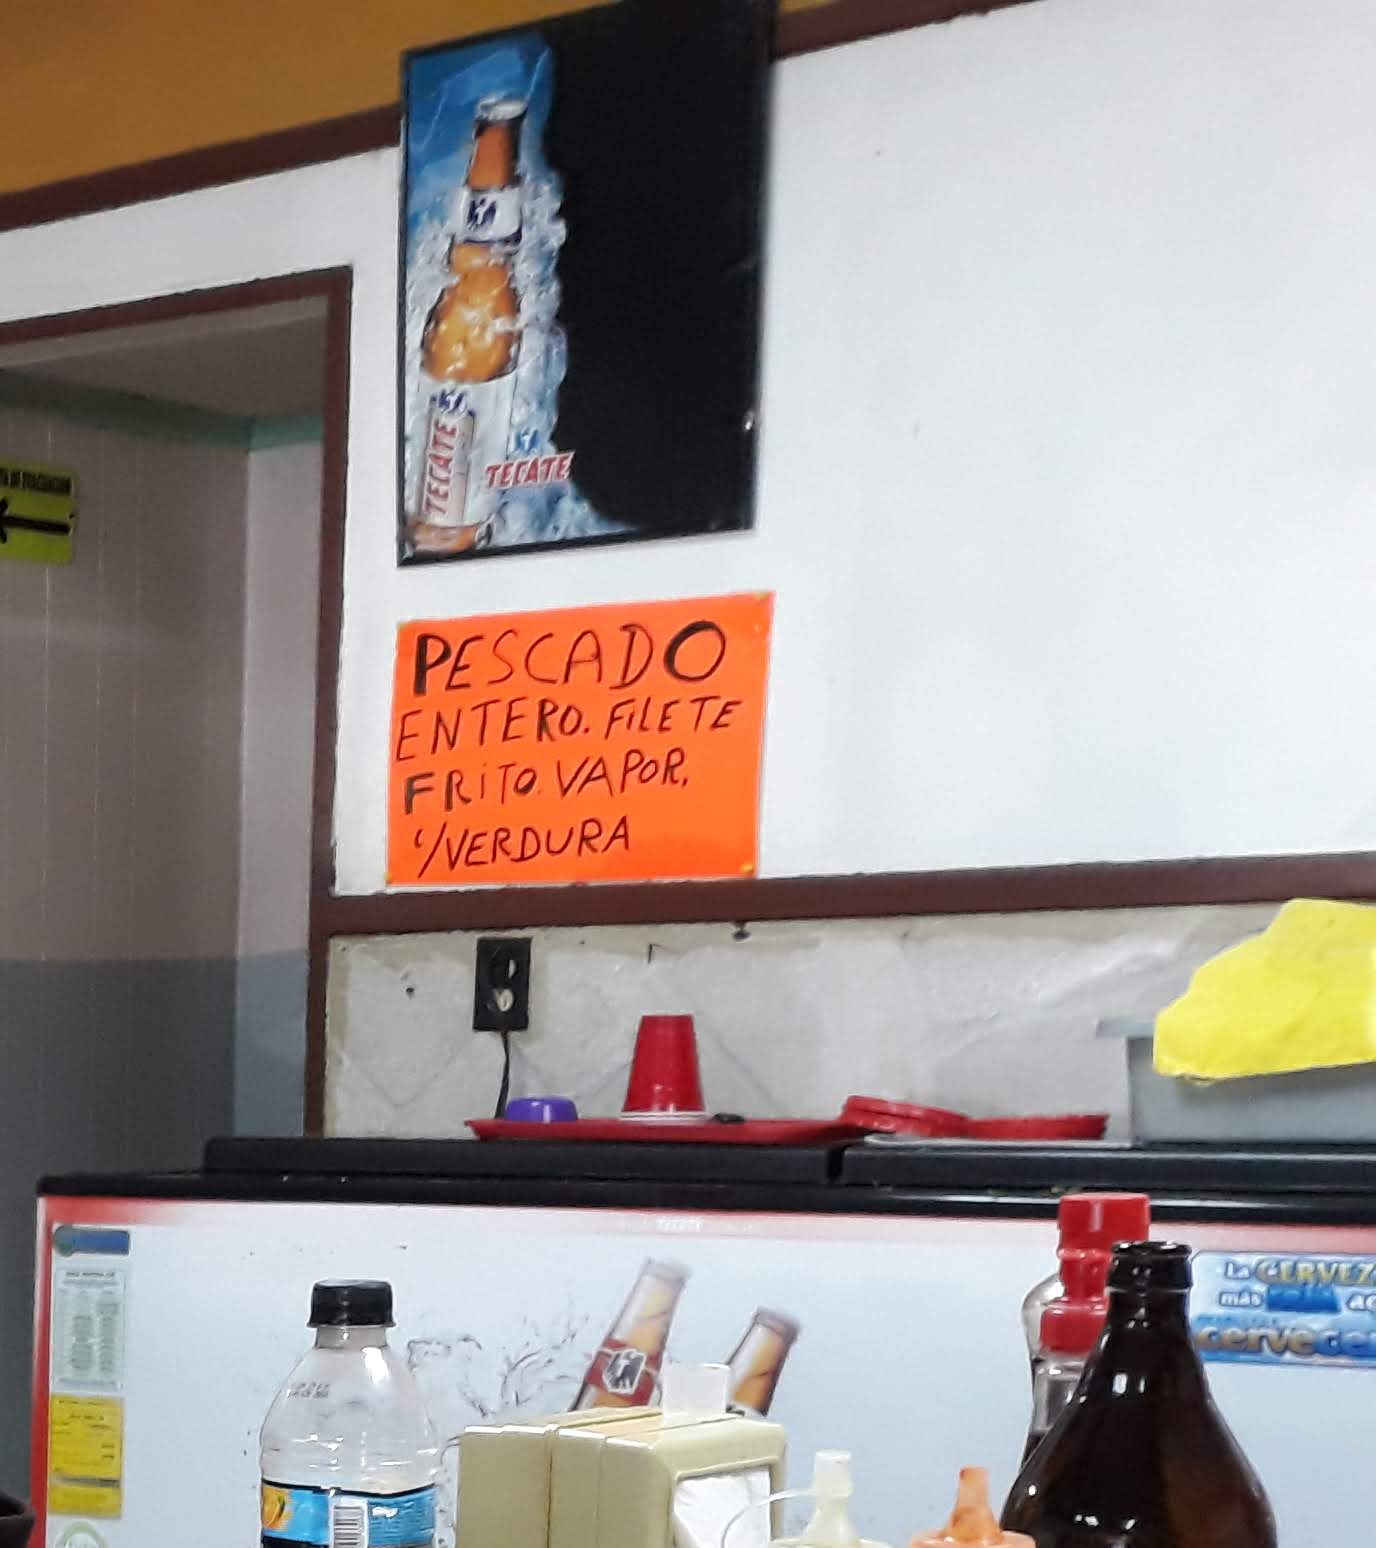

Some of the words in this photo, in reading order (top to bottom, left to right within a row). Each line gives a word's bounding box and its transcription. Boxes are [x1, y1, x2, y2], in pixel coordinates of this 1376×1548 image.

[422, 419, 458, 515] TECATE
[486, 452, 575, 489] TECATE
[413, 620, 726, 697] PESCADO
[1256, 1257, 1376, 1284] CERVEZ
